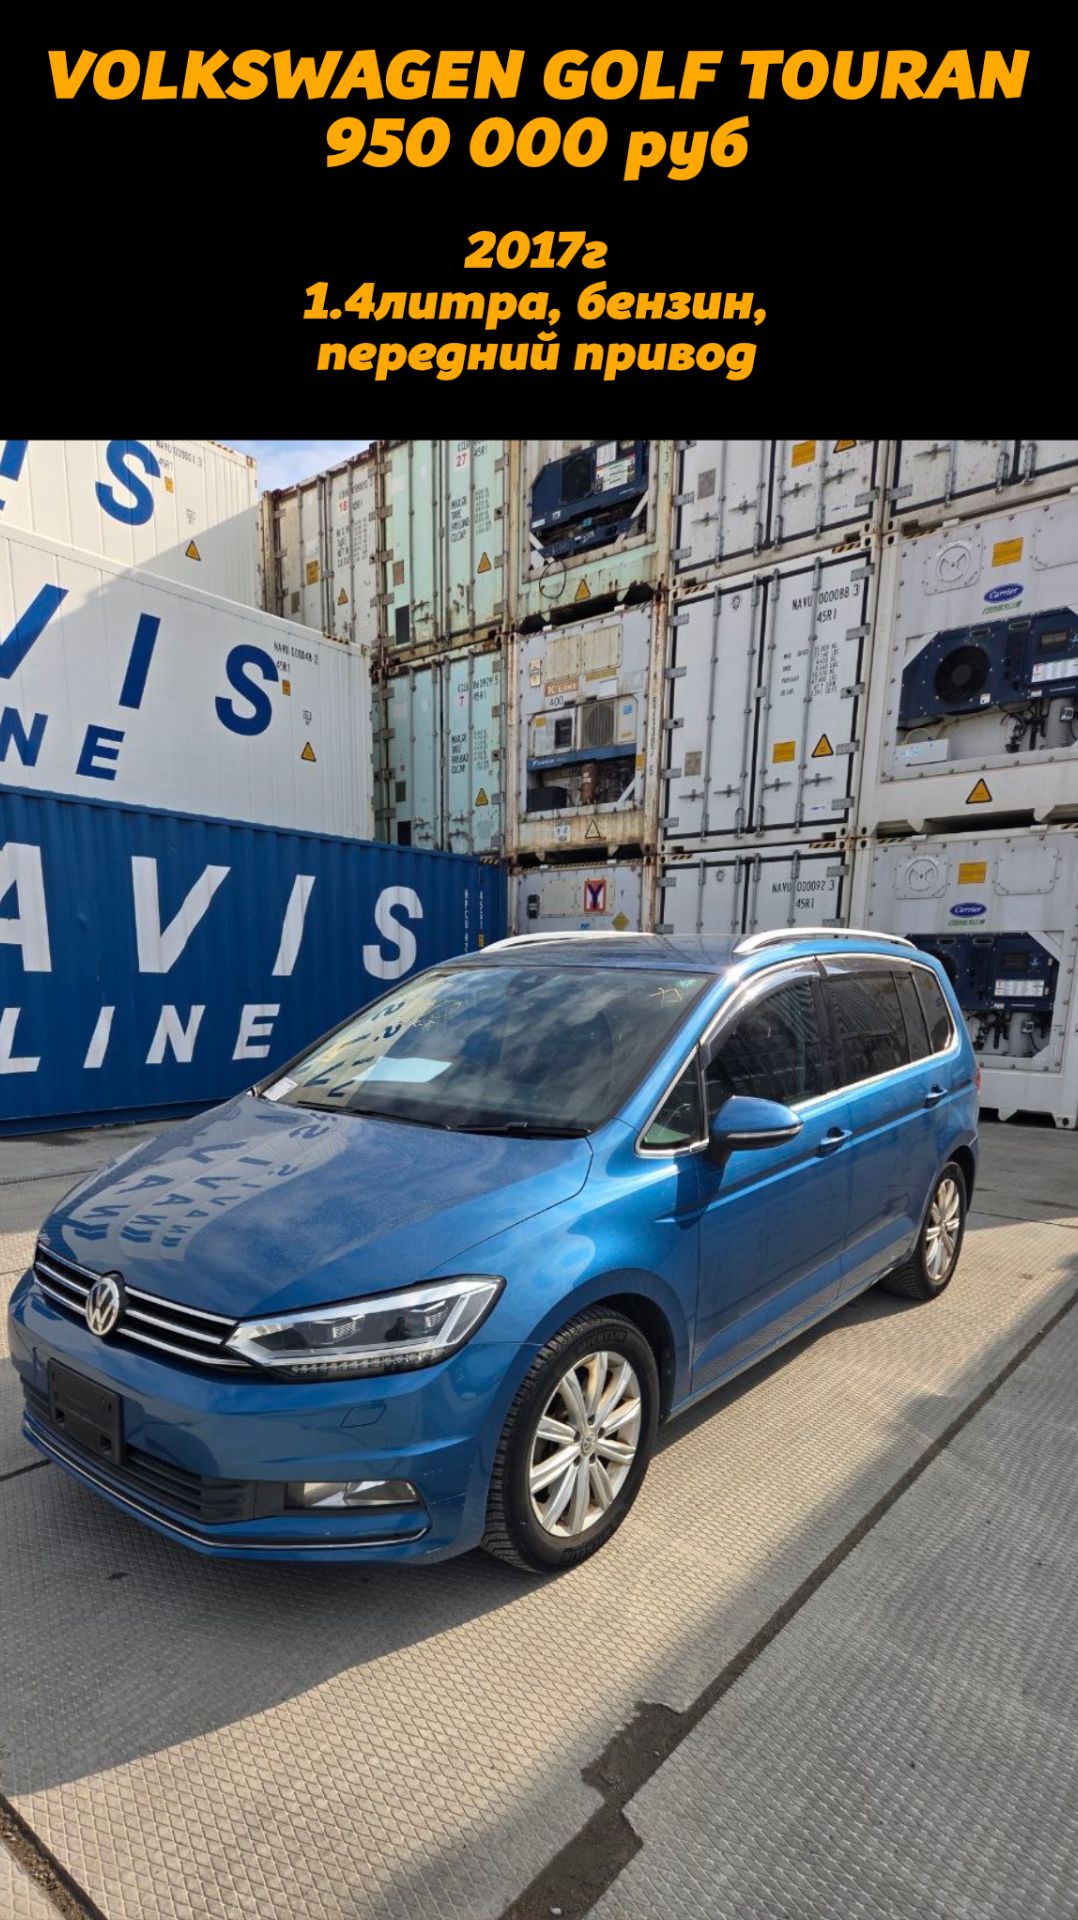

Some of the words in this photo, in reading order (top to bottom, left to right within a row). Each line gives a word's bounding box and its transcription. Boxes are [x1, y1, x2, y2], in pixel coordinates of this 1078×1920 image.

[456, 453, 467, 468] 27
[792, 593, 813, 611] NAVU
[818, 586, 850, 605] 000088
[854, 583, 859, 597] 3
[817, 608, 837, 623] 45R1
[772, 882, 791, 894] NAVU
[828, 879, 835, 892] 3
[796, 898, 815, 909] 45R1
[0, 1004, 281, 1074] LINE
